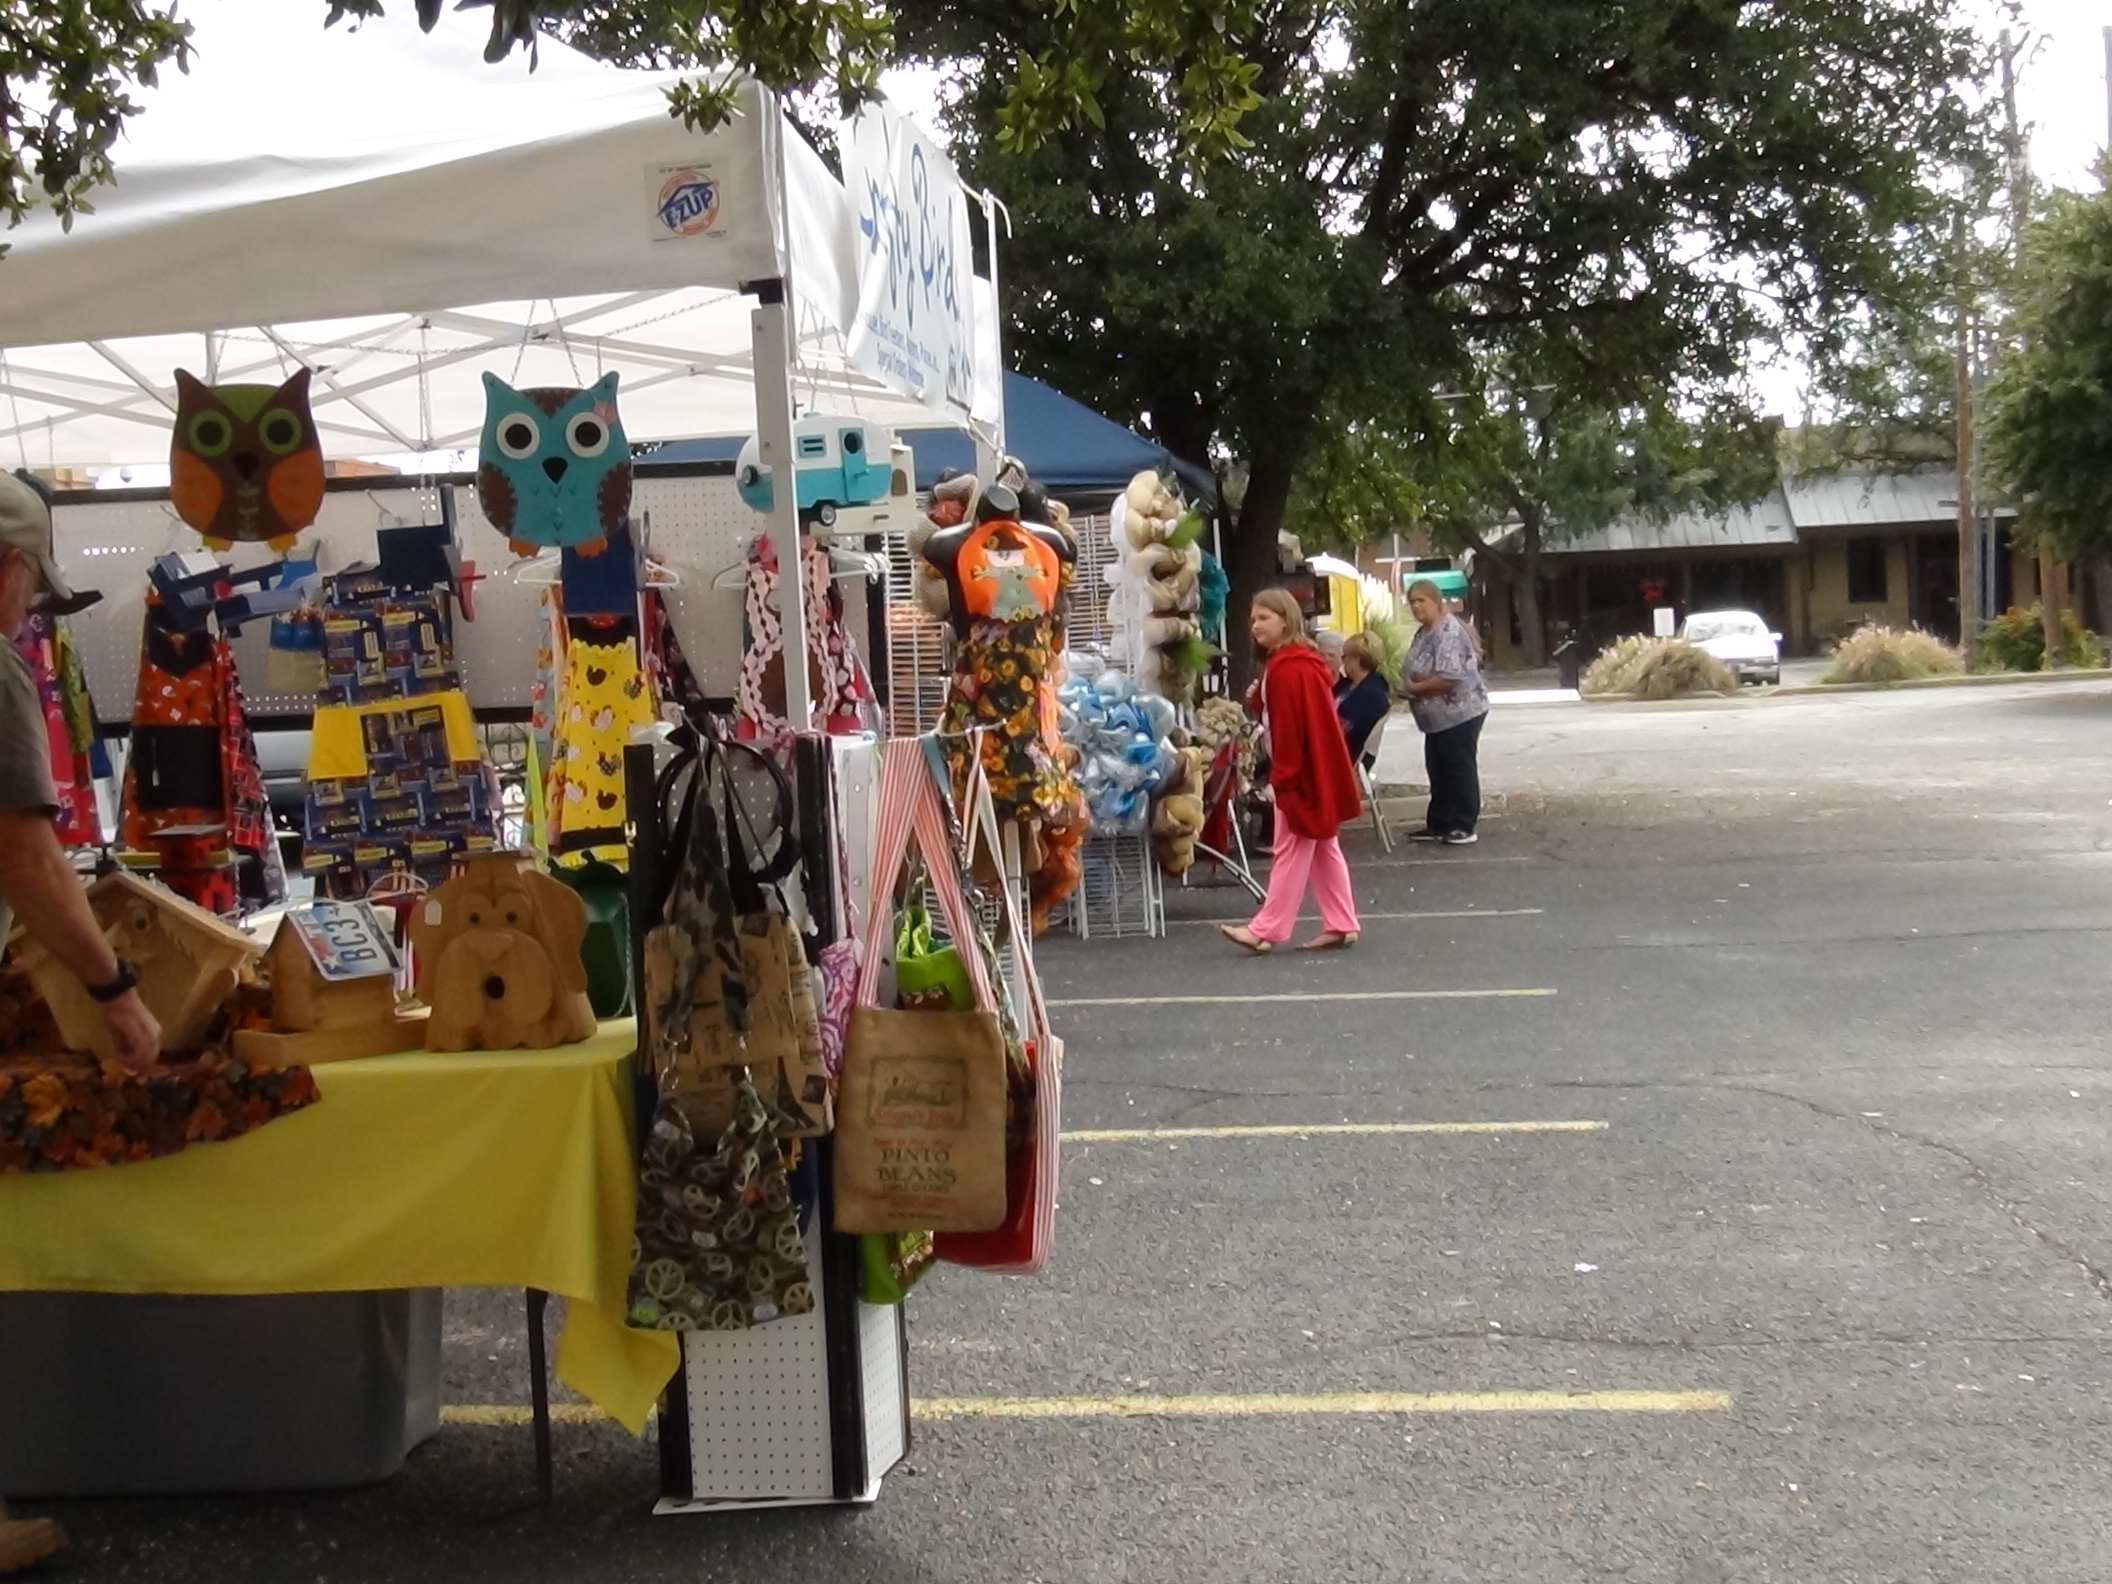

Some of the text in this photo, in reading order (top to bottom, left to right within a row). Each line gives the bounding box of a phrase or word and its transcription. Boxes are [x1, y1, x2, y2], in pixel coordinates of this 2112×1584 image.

[911, 142, 960, 323] Bird
[323, 918, 378, 962] BC3
[881, 1148, 950, 1163] PINTO
[876, 1165, 958, 1184] BEANS
